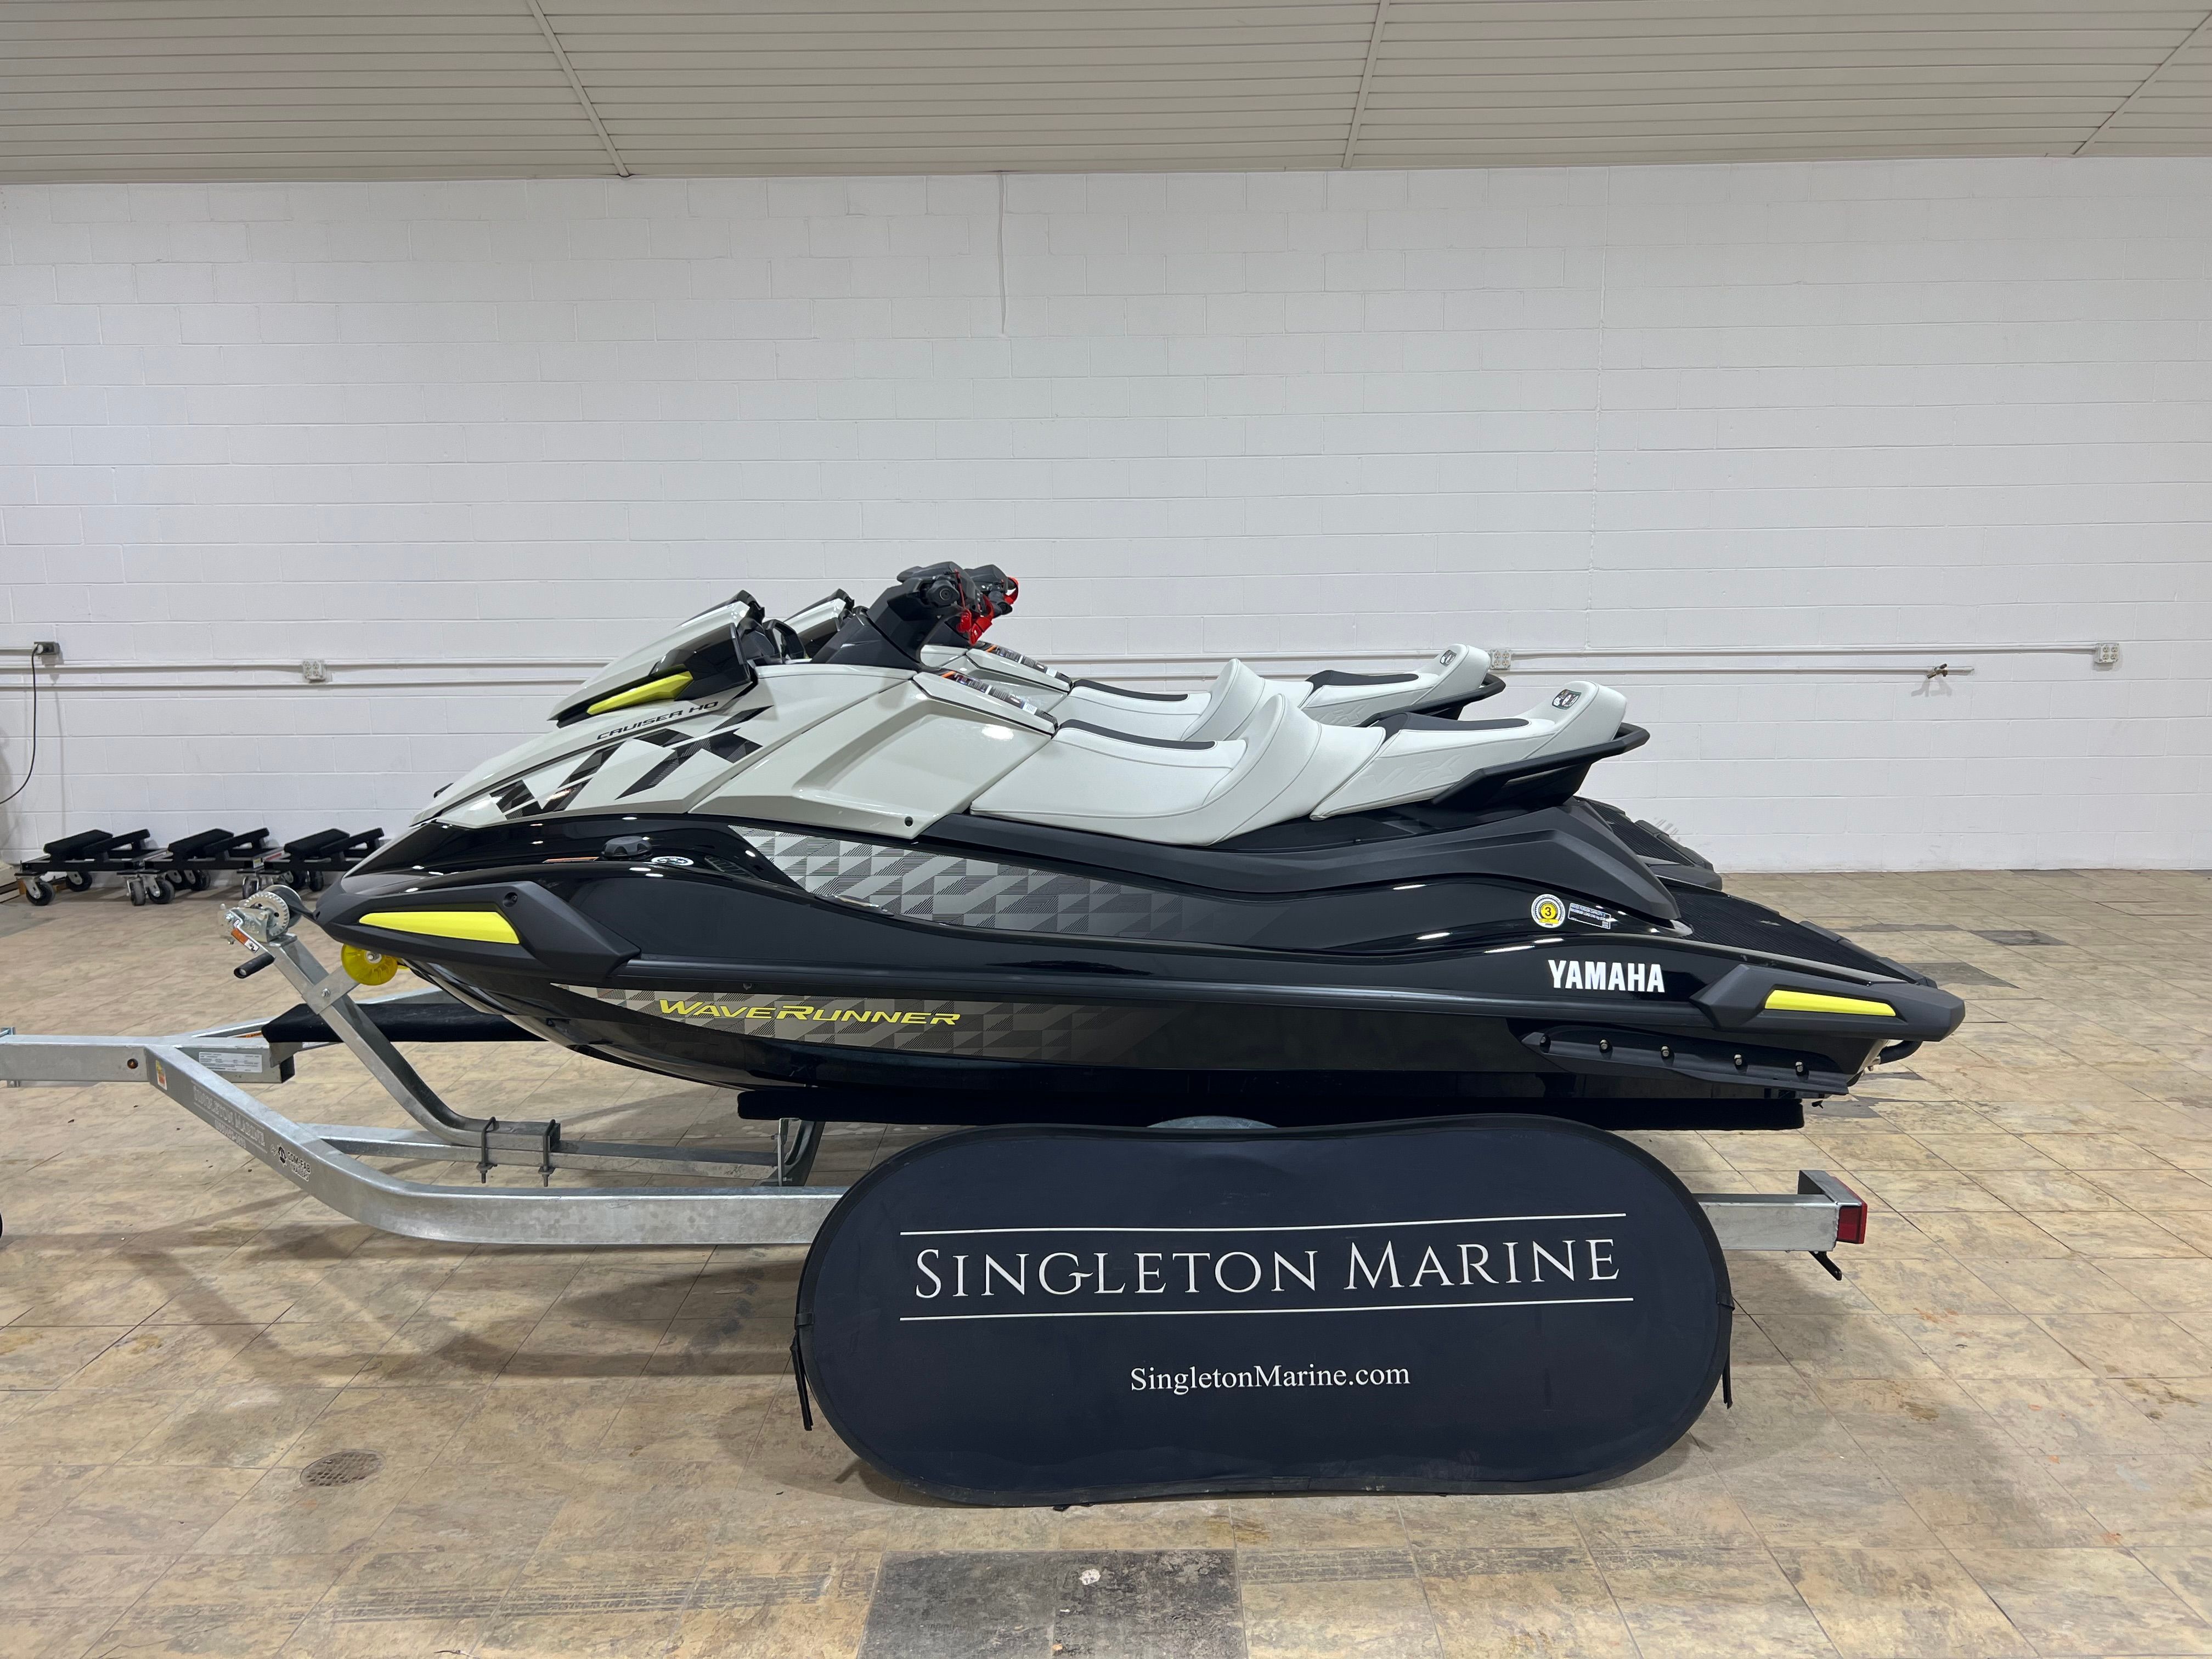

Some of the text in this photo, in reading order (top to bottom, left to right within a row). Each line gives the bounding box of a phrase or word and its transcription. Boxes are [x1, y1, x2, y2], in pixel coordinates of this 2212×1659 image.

[596, 701, 719, 741] CRUISER HO
[1544, 906, 1551, 917] 3
[1548, 960, 1665, 992] YAMAHA
[916, 1239, 1620, 1299] SINGLETON MARINE
[1131, 1363, 1410, 1395] SingletonMarine.com
